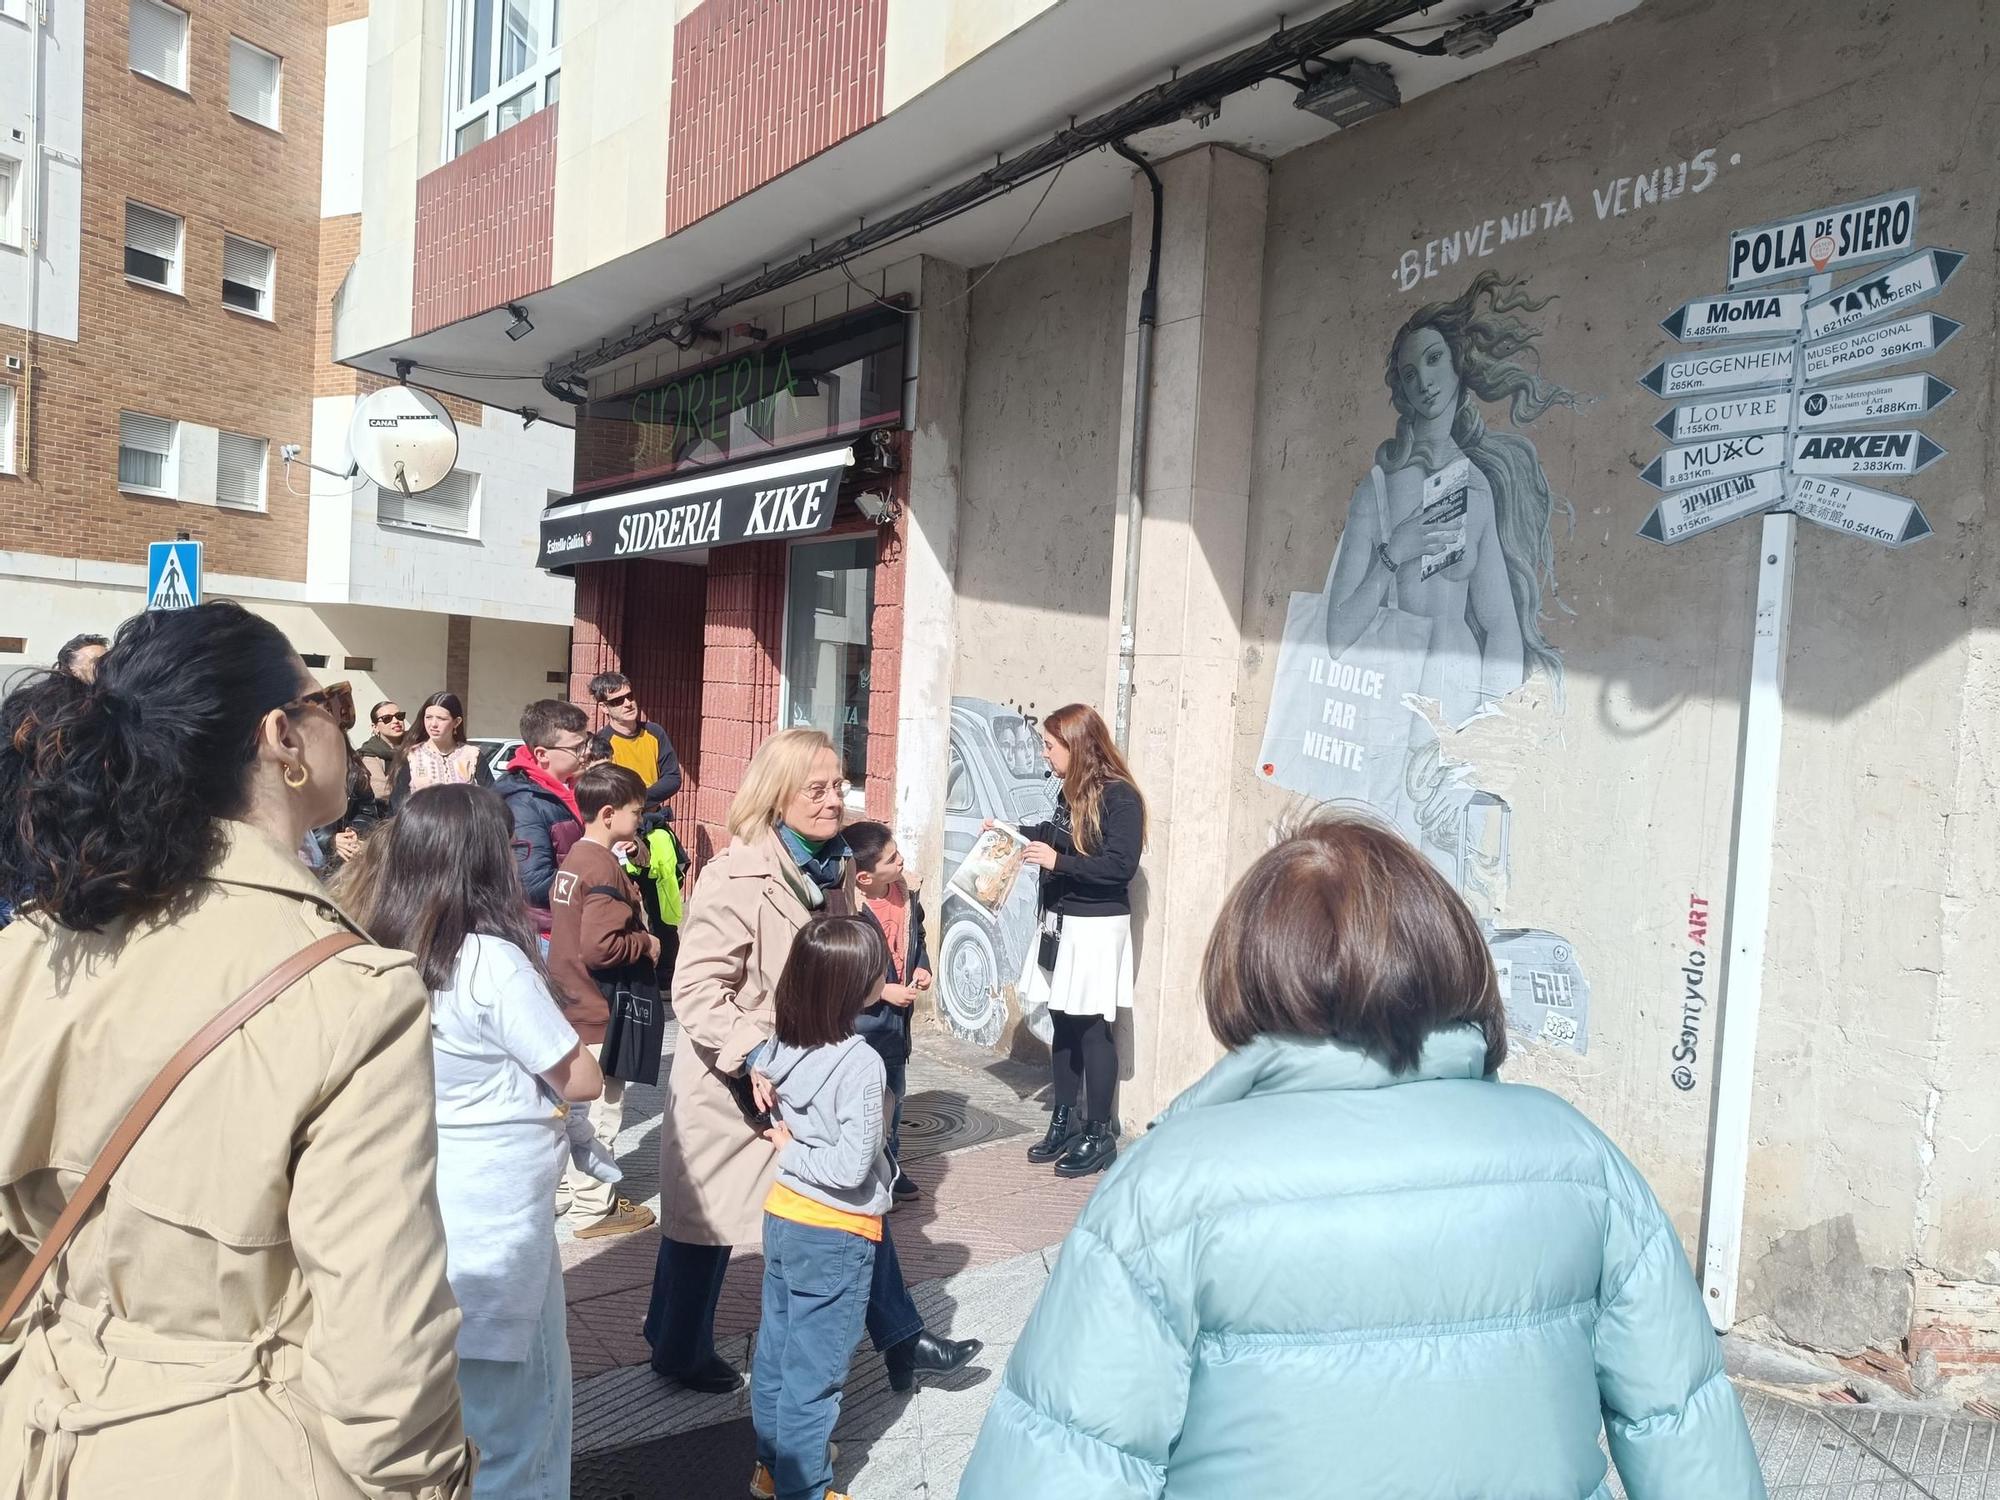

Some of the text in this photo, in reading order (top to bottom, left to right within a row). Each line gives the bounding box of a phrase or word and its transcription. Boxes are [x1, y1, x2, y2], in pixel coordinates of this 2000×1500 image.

[1732, 200, 1910, 278] POLA DE SIERO
[1869, 280, 1922, 310] MODERN
[1707, 298, 1781, 323] MoMA
[1807, 323, 1912, 360] MUSEO NACIONAL
[1670, 350, 1793, 378] GUGGENHEIM
[1808, 345, 1874, 372] DEL PRADO
[1829, 400, 1860, 410] Museum
[1845, 387, 1893, 400] Metropolitan
[1799, 434, 1912, 459] ARKEN
[1799, 492, 1847, 510] ART MUSEUM
[1802, 480, 1852, 501] MORI
[615, 479, 828, 556] SIDRERIA KIKE
[1308, 656, 1385, 700] IL DOLCE
[1322, 698, 1357, 730] FAR
[1302, 729, 1365, 772] NIENTE
[558, 877, 571, 895] K
